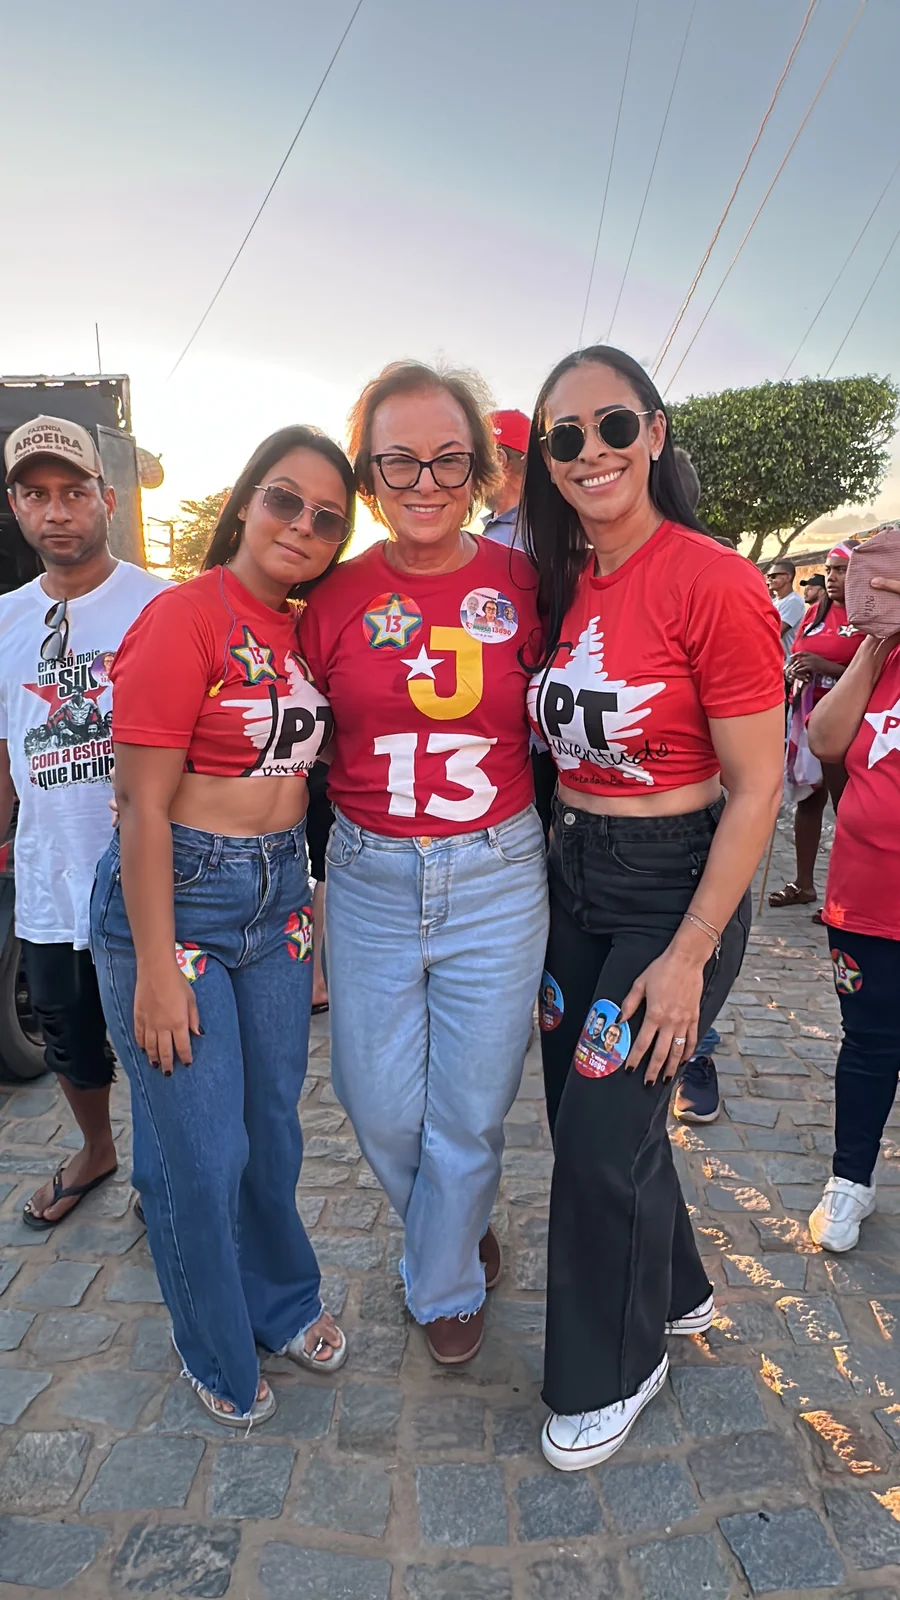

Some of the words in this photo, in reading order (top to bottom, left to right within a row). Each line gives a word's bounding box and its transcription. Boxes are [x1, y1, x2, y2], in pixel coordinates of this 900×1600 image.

[28, 425, 62, 435] FAZENDA
[14, 433, 83, 454] AROEIRA
[385, 615, 402, 632] 13
[37, 658, 57, 673] era
[60, 653, 74, 668] só
[248, 647, 265, 665] 13
[38, 671, 56, 686] um
[407, 626, 484, 720] J
[544, 681, 619, 751] PT
[273, 706, 334, 759] PT
[32, 750, 59, 771] com
[62, 748, 70, 763] a
[73, 736, 114, 761] estrel
[37, 766, 68, 790] que
[71, 755, 114, 781] brilh
[374, 733, 498, 822] 13
[301, 926, 311, 943] 13
[837, 965, 847, 980] 13
